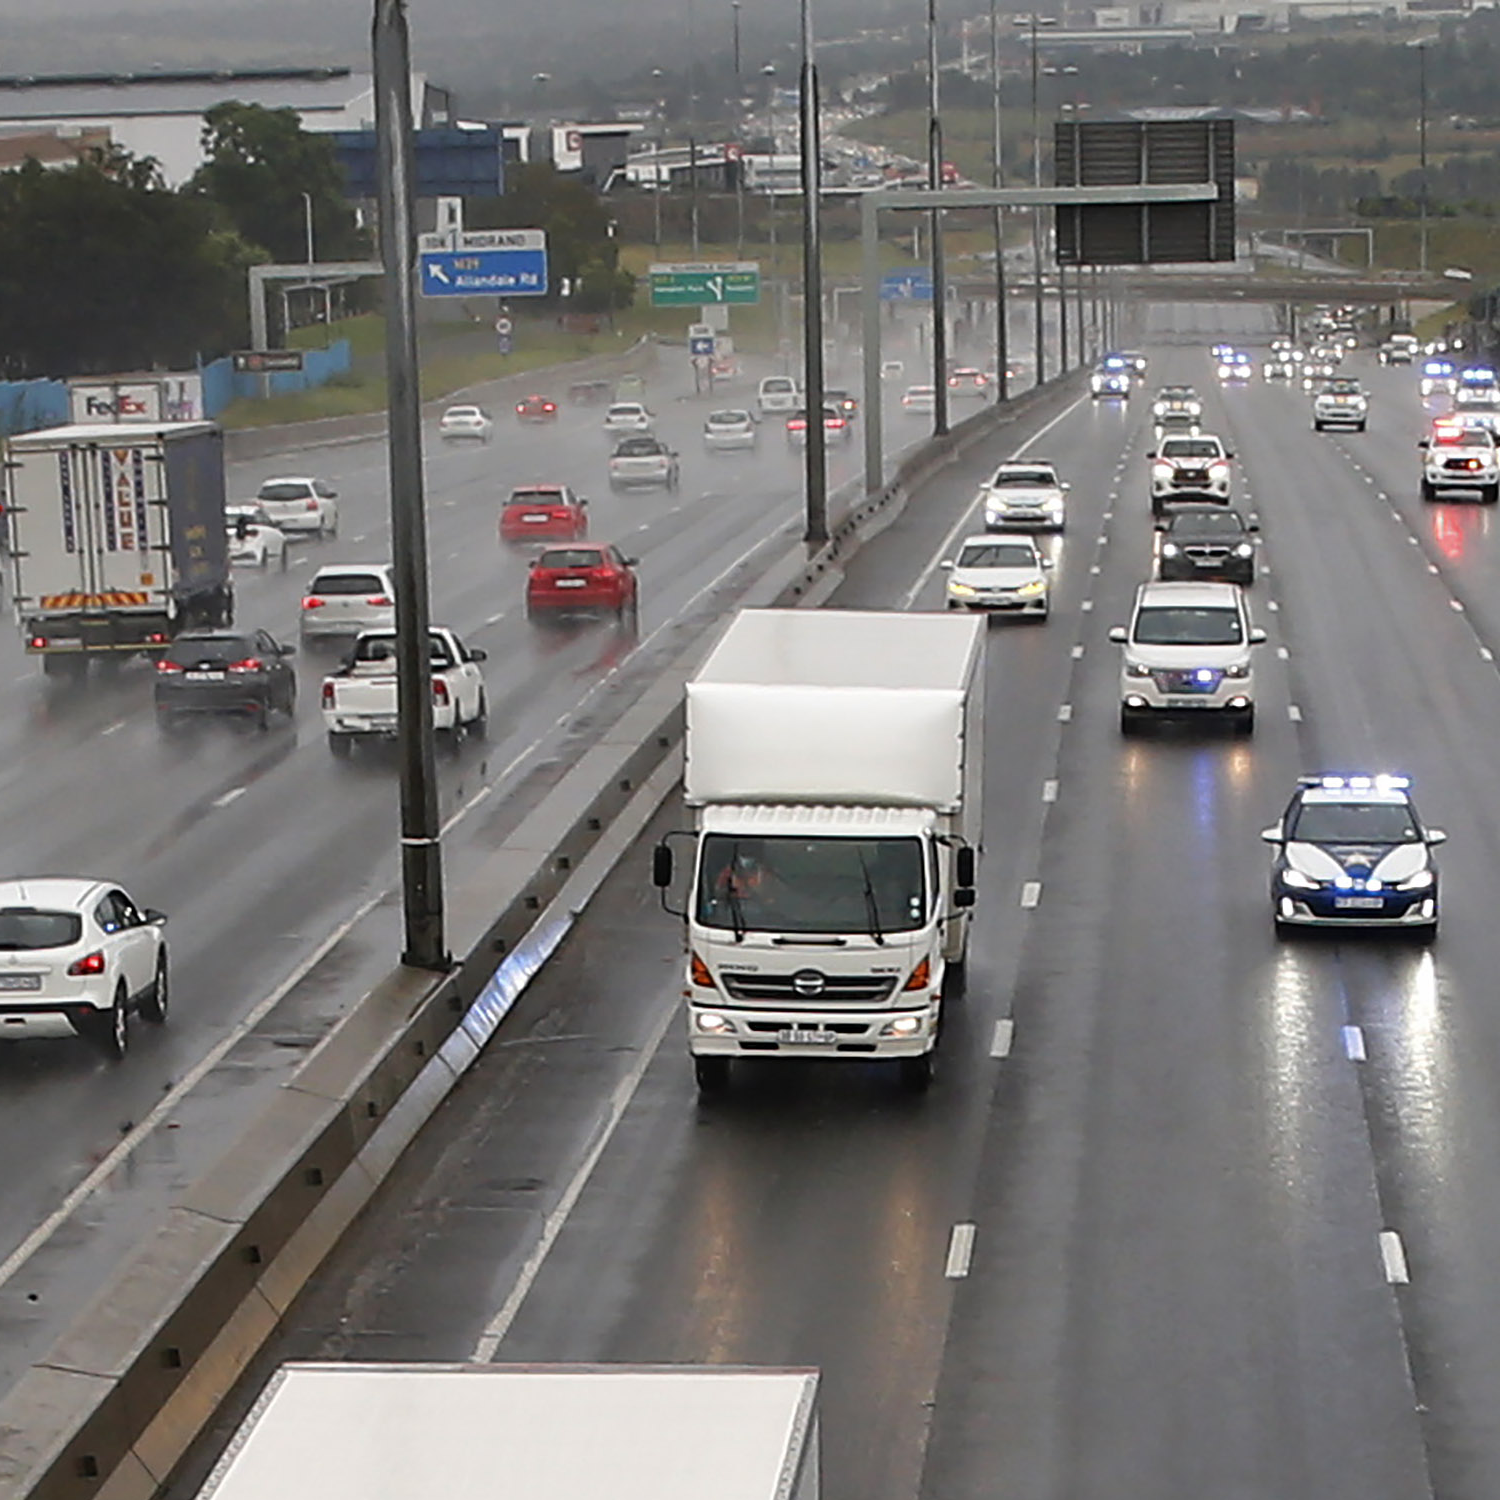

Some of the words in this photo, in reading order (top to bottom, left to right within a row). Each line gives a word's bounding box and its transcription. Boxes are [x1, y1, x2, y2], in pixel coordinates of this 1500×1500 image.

[463, 234, 525, 247] MIDRAND
[455, 273, 516, 286] Allandale
[520, 272, 538, 285] Rd
[86, 395, 147, 416] FedEx
[113, 450, 135, 551] VALUE
